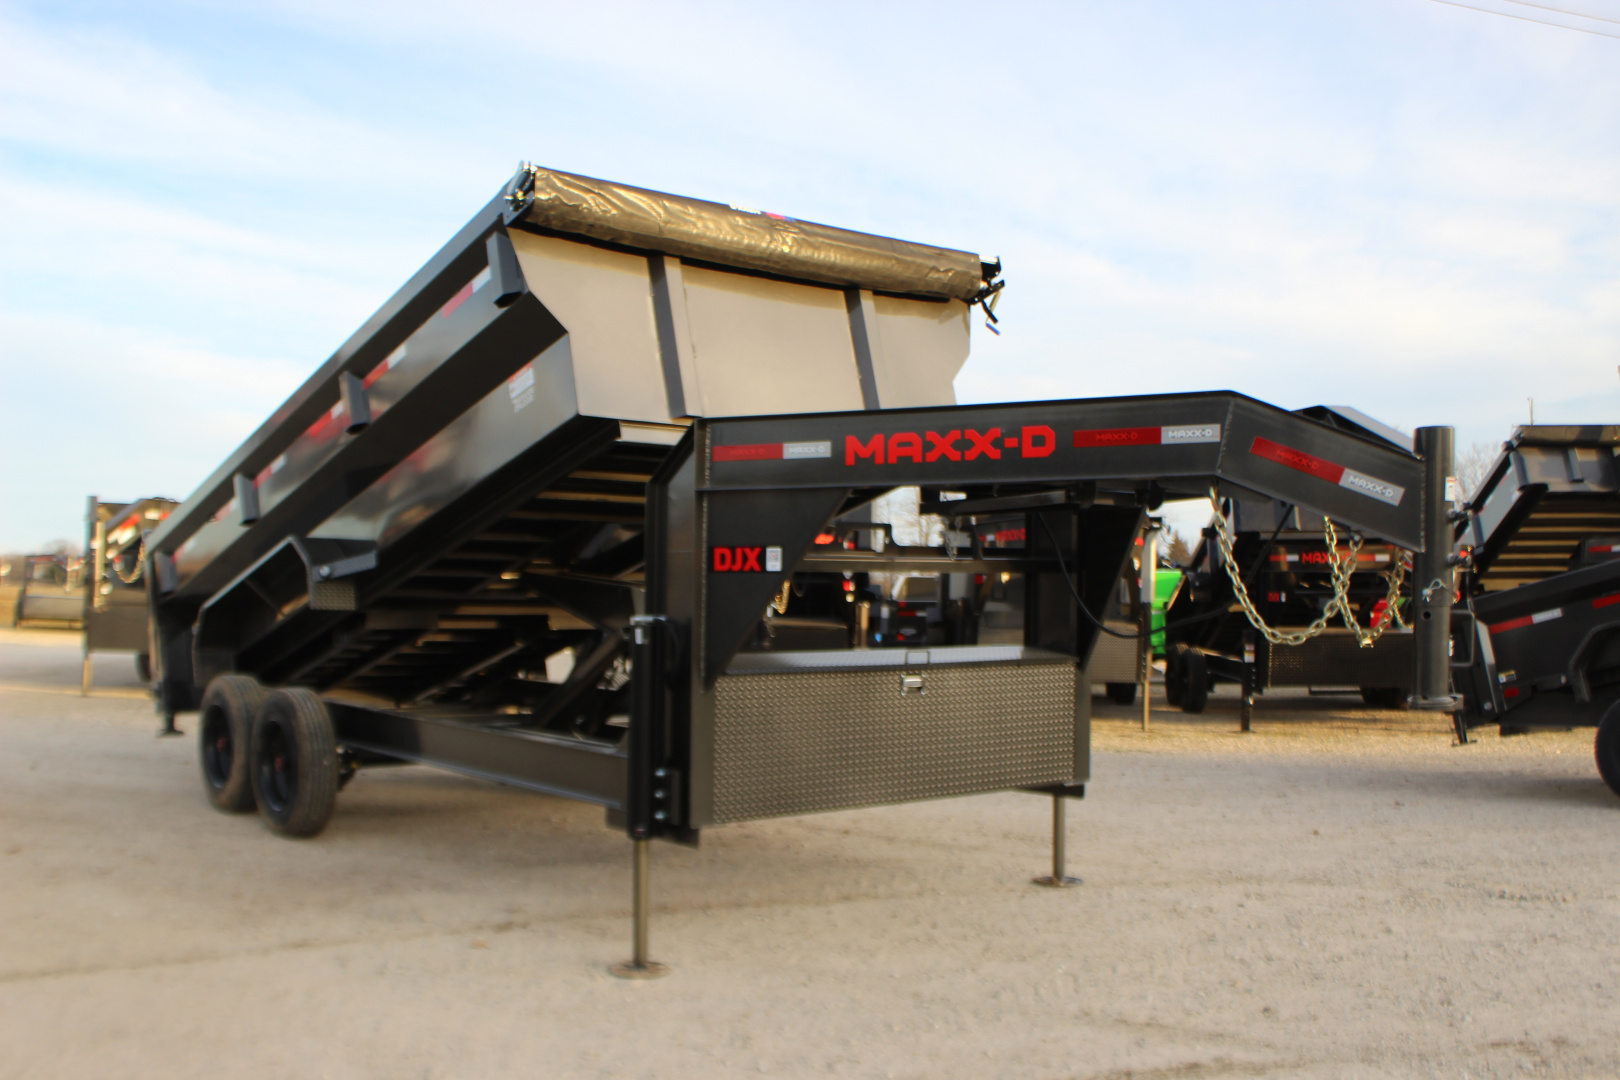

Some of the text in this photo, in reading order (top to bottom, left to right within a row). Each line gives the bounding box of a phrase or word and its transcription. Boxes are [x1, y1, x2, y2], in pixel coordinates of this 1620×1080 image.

[1095, 432, 1138, 441] MAXX-D
[1168, 428, 1213, 438] MAXX-D
[845, 425, 1056, 466] MAXX-D
[1275, 449, 1320, 470] MAXX-D
[1348, 475, 1394, 498] MAXX-D
[713, 546, 762, 572] DJX
